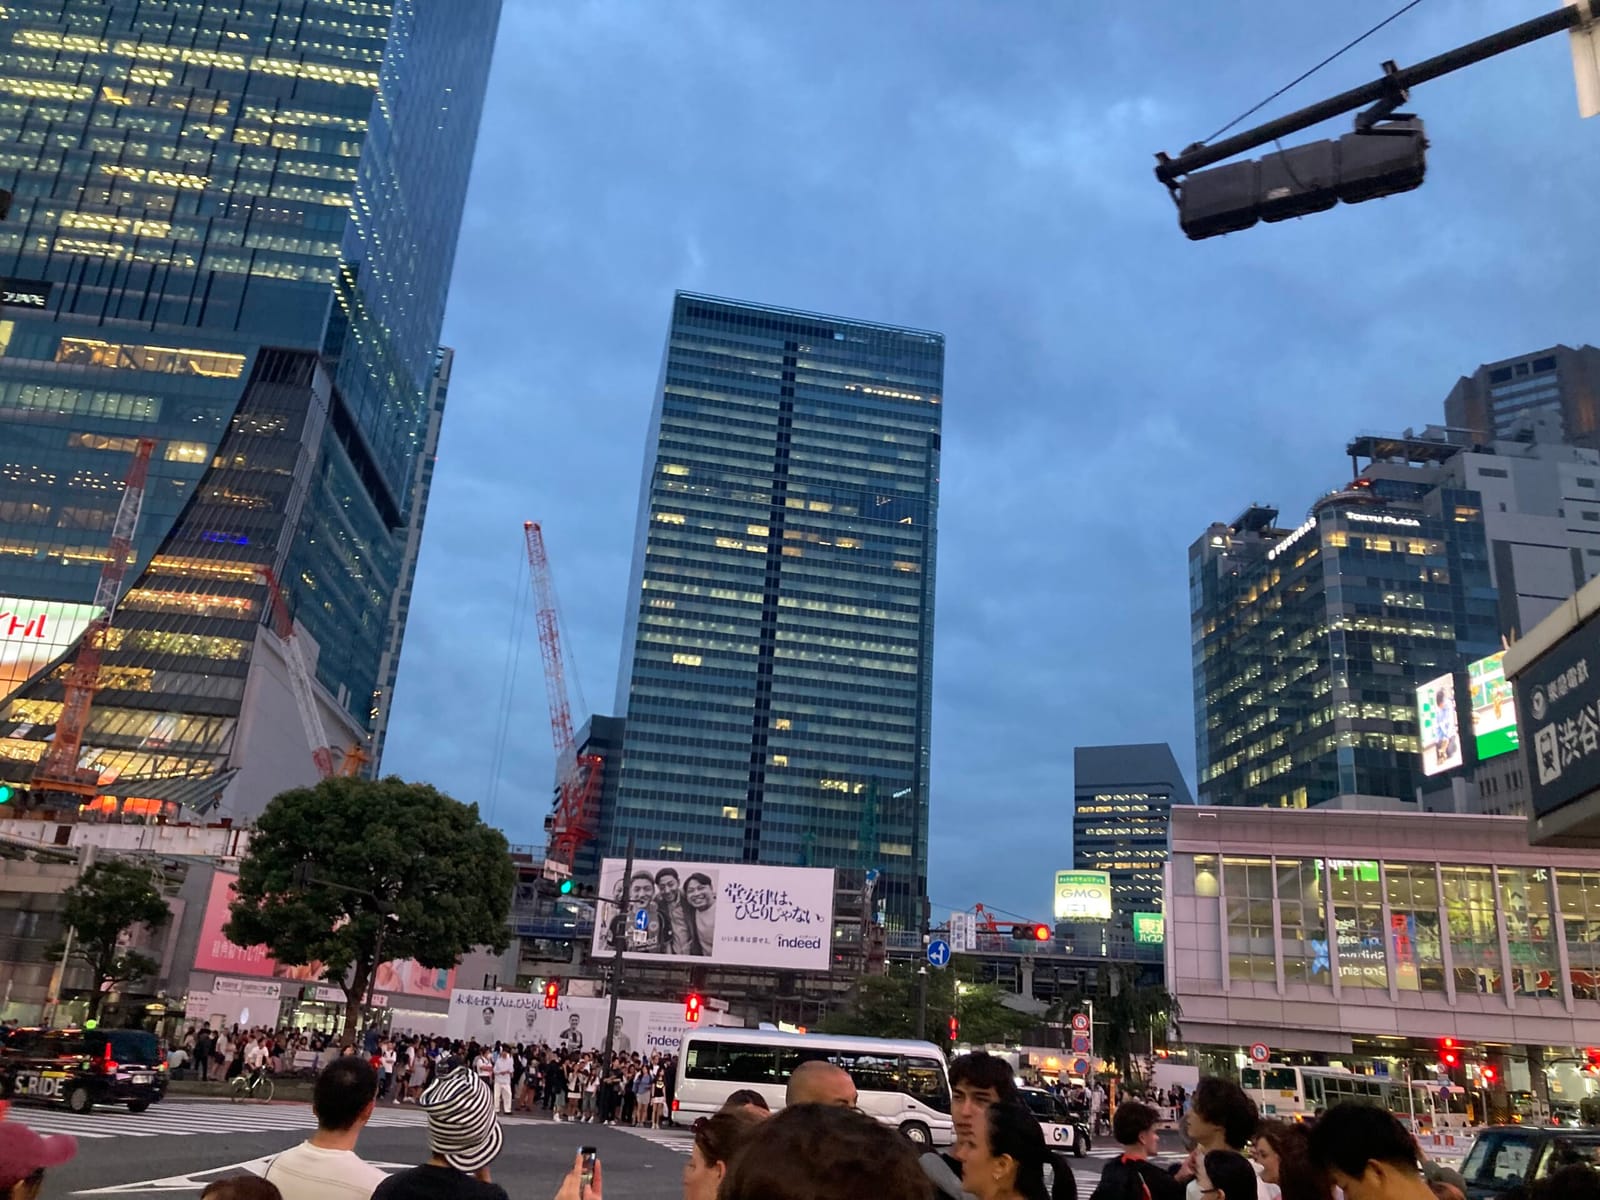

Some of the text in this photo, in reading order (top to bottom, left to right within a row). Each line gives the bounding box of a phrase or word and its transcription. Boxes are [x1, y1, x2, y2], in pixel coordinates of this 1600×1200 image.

[1345, 511, 1421, 527] TOKYU PLAZA
[1275, 516, 1317, 556] FUKURAS
[1558, 699, 1600, 768] 渋谷
[1061, 888, 1102, 899] GMO
[735, 902, 825, 924] ひとりじゃない。
[777, 935, 821, 949] indeed
[646, 1034, 681, 1047] indee
[1053, 1127, 1069, 1142] GO
